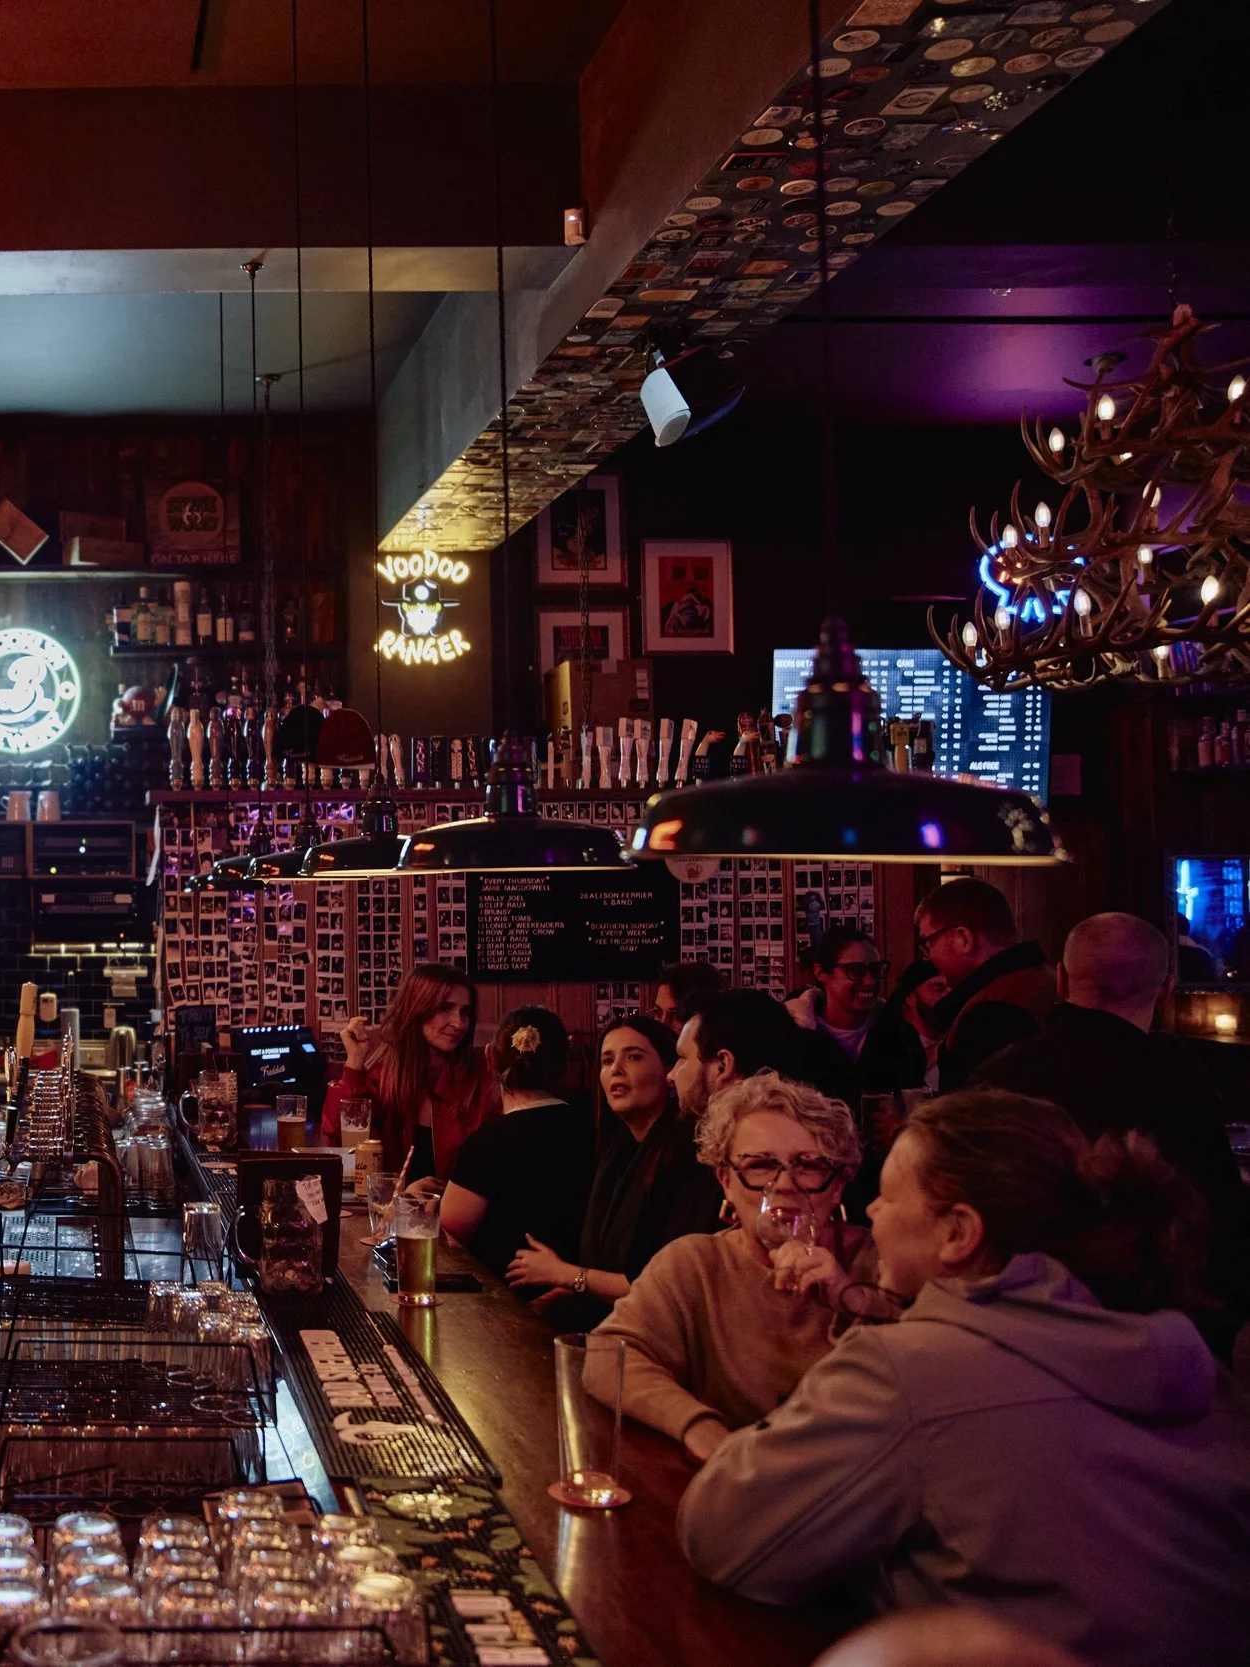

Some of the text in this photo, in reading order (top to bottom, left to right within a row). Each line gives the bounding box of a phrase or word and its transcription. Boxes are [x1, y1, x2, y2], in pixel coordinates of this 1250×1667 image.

[151, 553, 173, 564] ON
[176, 552, 200, 564] TAP
[374, 550, 471, 666] VOODOO RANGER
